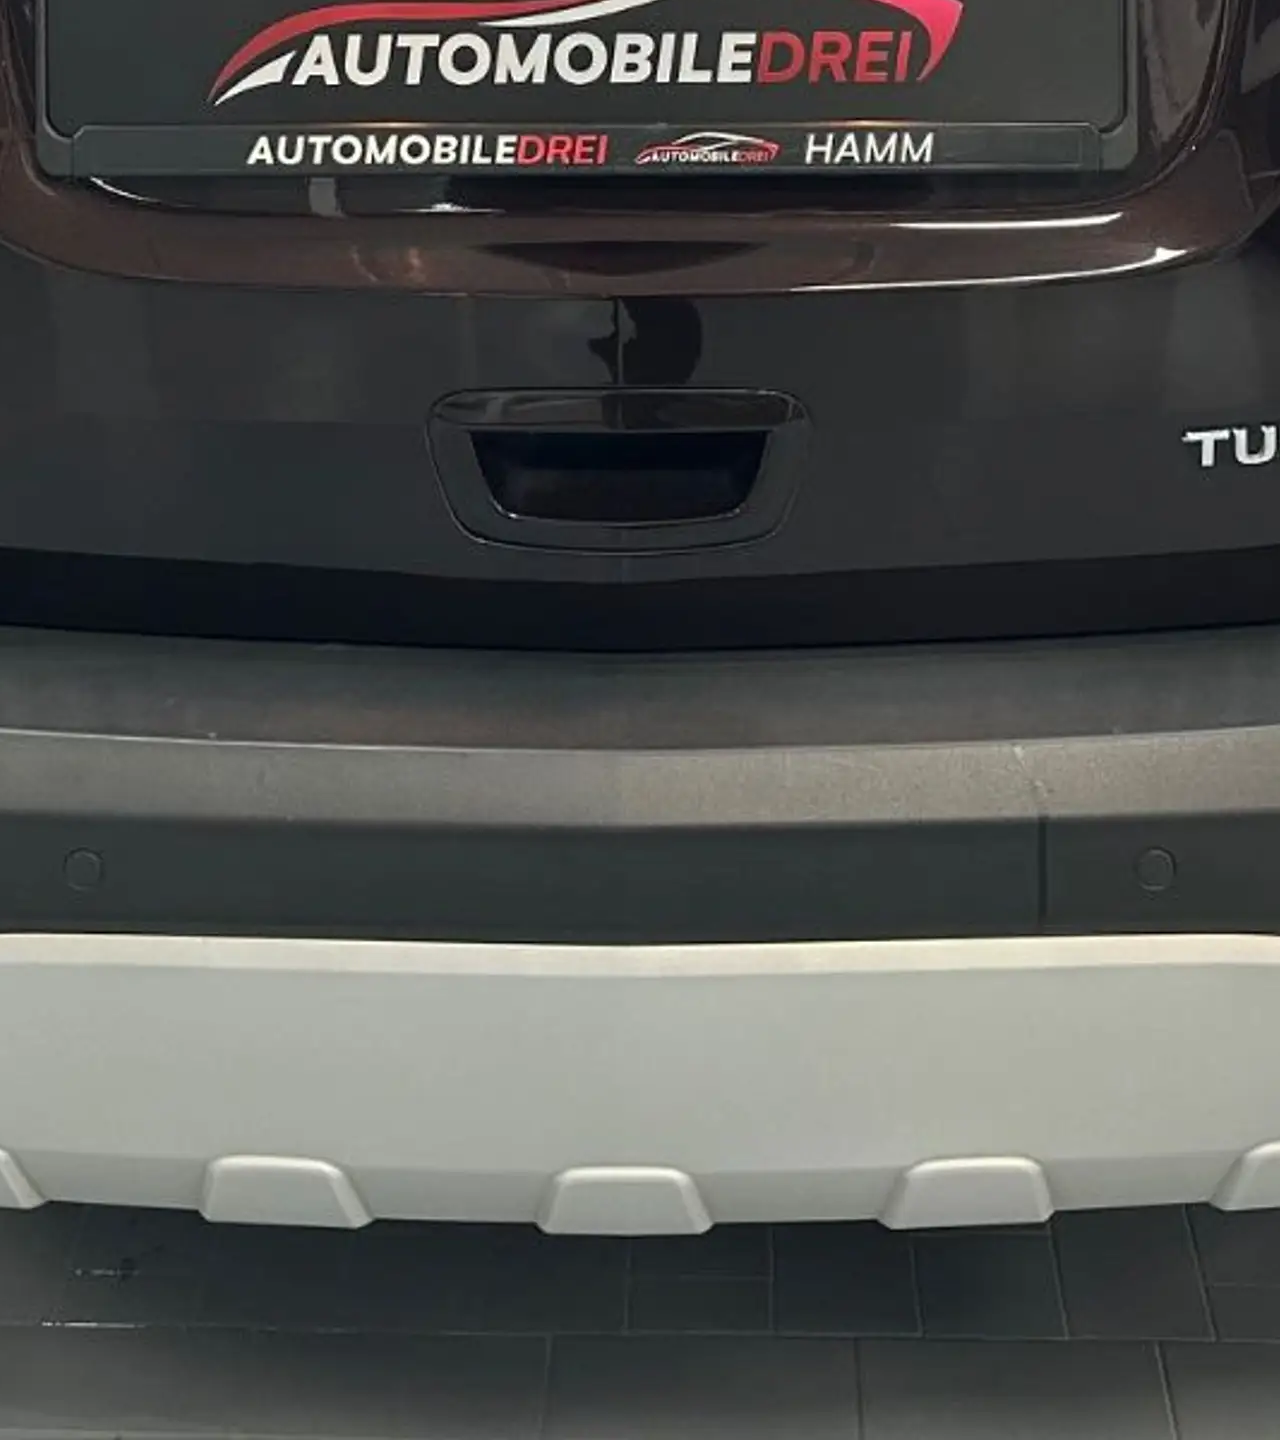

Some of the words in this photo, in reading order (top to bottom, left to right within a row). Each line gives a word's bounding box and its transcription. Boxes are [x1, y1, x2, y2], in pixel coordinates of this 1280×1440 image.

[291, 31, 914, 87] AUTOMOBILEDREI
[246, 133, 609, 166] AUTOMOBILEDREI
[650, 149, 771, 164] AUTOMOBILEDREI
[804, 132, 936, 165] HAMM
